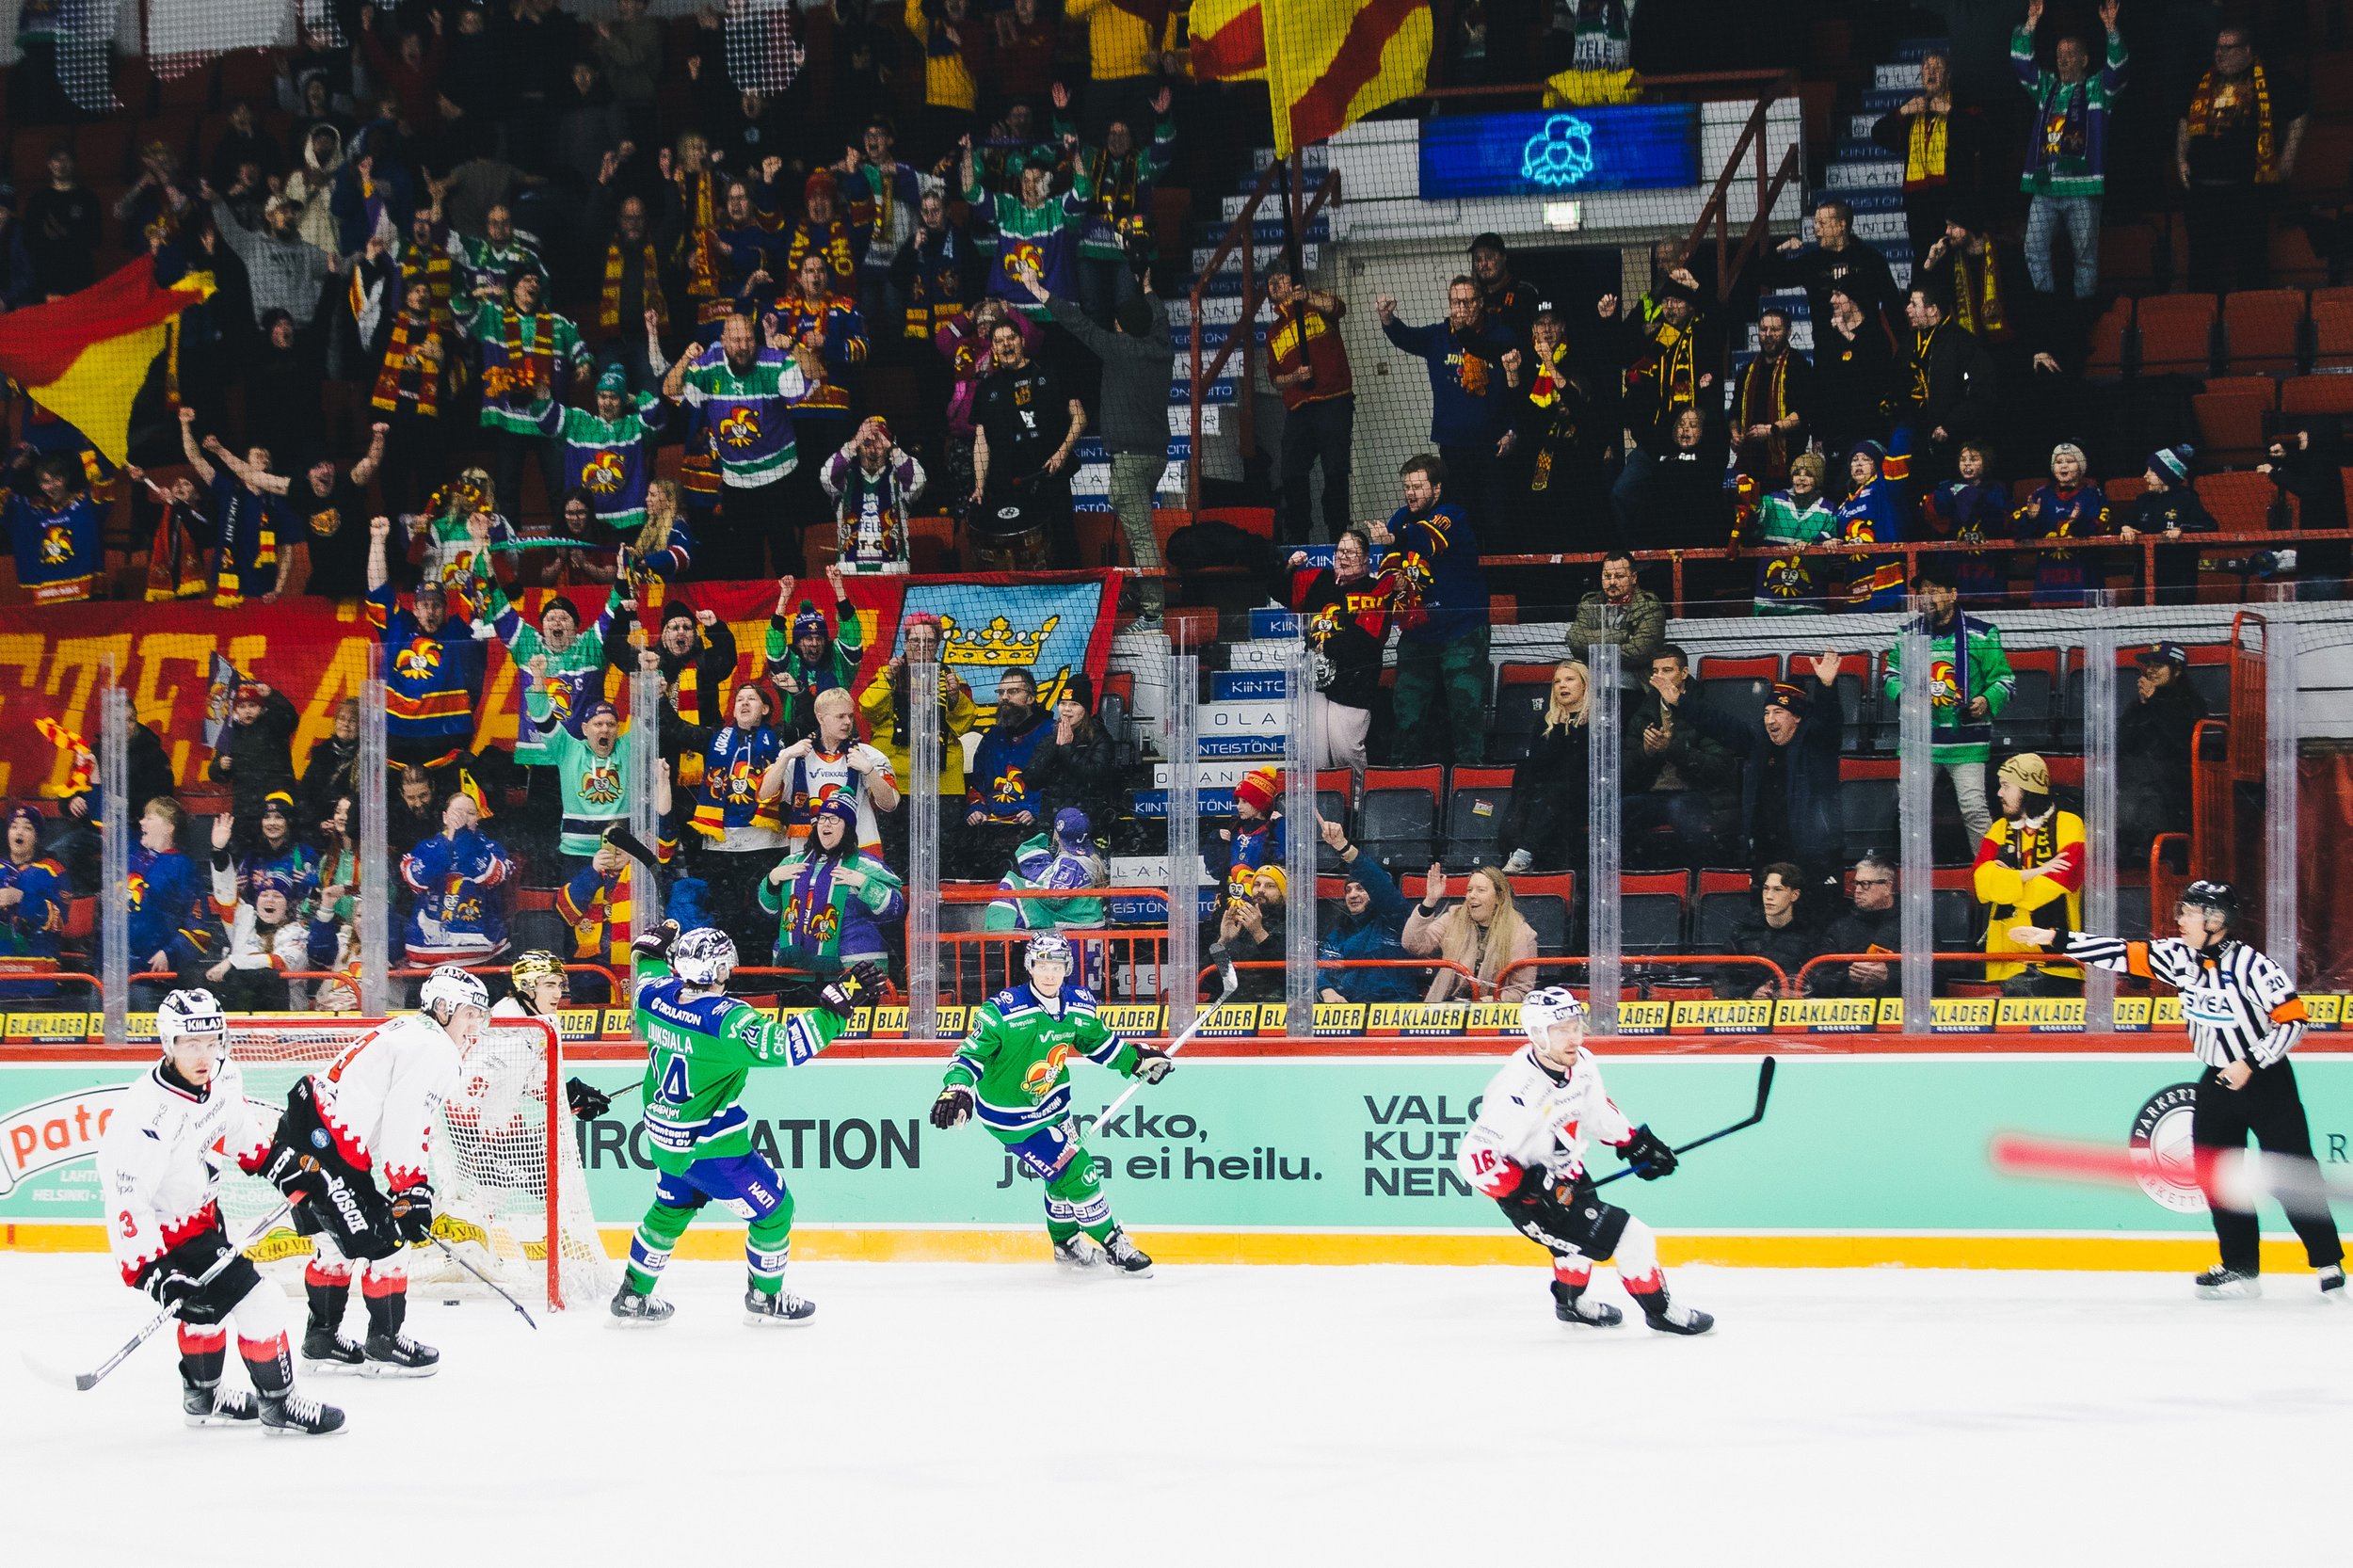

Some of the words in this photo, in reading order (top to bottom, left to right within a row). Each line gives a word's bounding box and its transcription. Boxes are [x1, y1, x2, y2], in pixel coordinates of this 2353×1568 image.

[659, 1001, 702, 1027] CIRCULATION
[1099, 1007, 1156, 1028] KLÄDER
[1196, 1006, 1253, 1028] KLÄDER
[1372, 1004, 1460, 1027] BLÅKLÄDER
[1472, 1003, 1523, 1026] BLÅKL
[1676, 1001, 1768, 1025] BLÅKLÄDER
[1779, 1000, 1870, 1023] BLÅKLÄDER
[2002, 999, 2083, 1022] BLÅKLÄDE
[773, 1026, 786, 1055] CHS
[1024, 1151, 1055, 1177] HALTI
[1127, 1145, 1171, 1180] ei
[1184, 1145, 1323, 1180] heilu.
[747, 1180, 776, 1210] HALTI
[1364, 1167, 1474, 1196] NEN
[119, 1209, 138, 1239] 3
